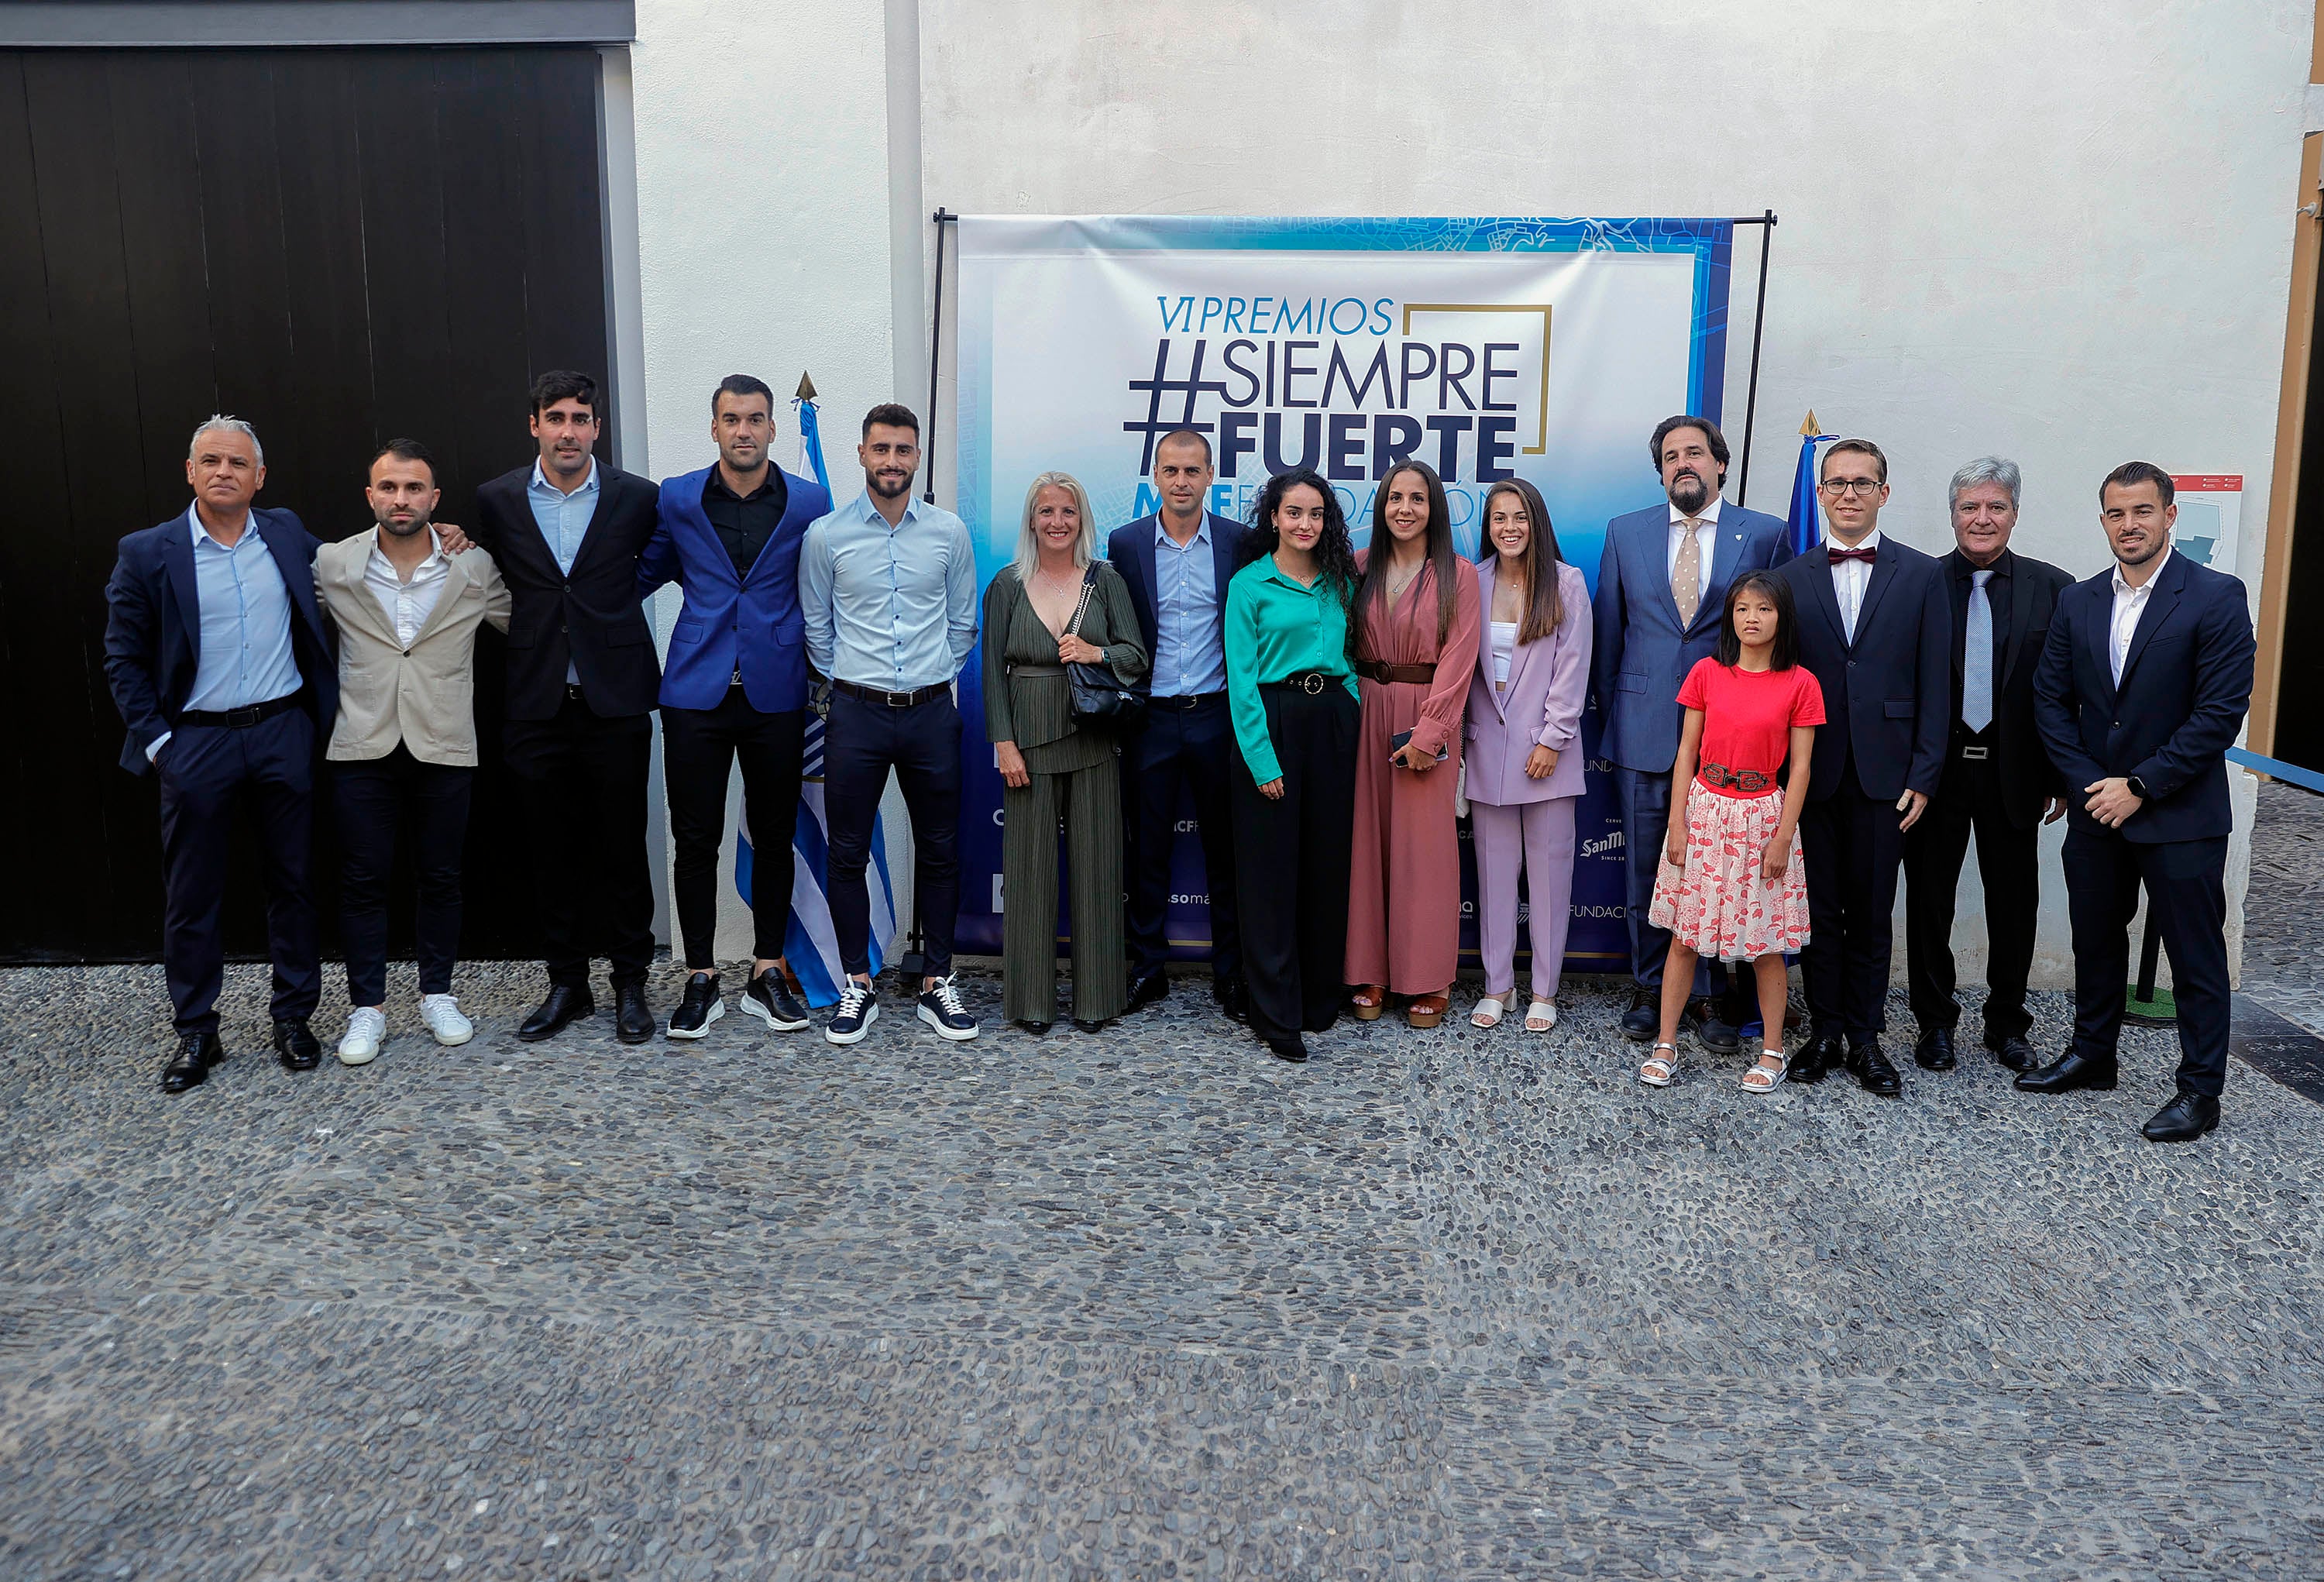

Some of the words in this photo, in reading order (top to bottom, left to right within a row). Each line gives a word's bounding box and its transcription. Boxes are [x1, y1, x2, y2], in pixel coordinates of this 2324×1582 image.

[1157, 296, 1195, 334] VI
[1199, 296, 1394, 335] PREMIOS
[1122, 339, 1519, 476] #SIEMPRE
[1220, 412, 1516, 483] FUERTE
